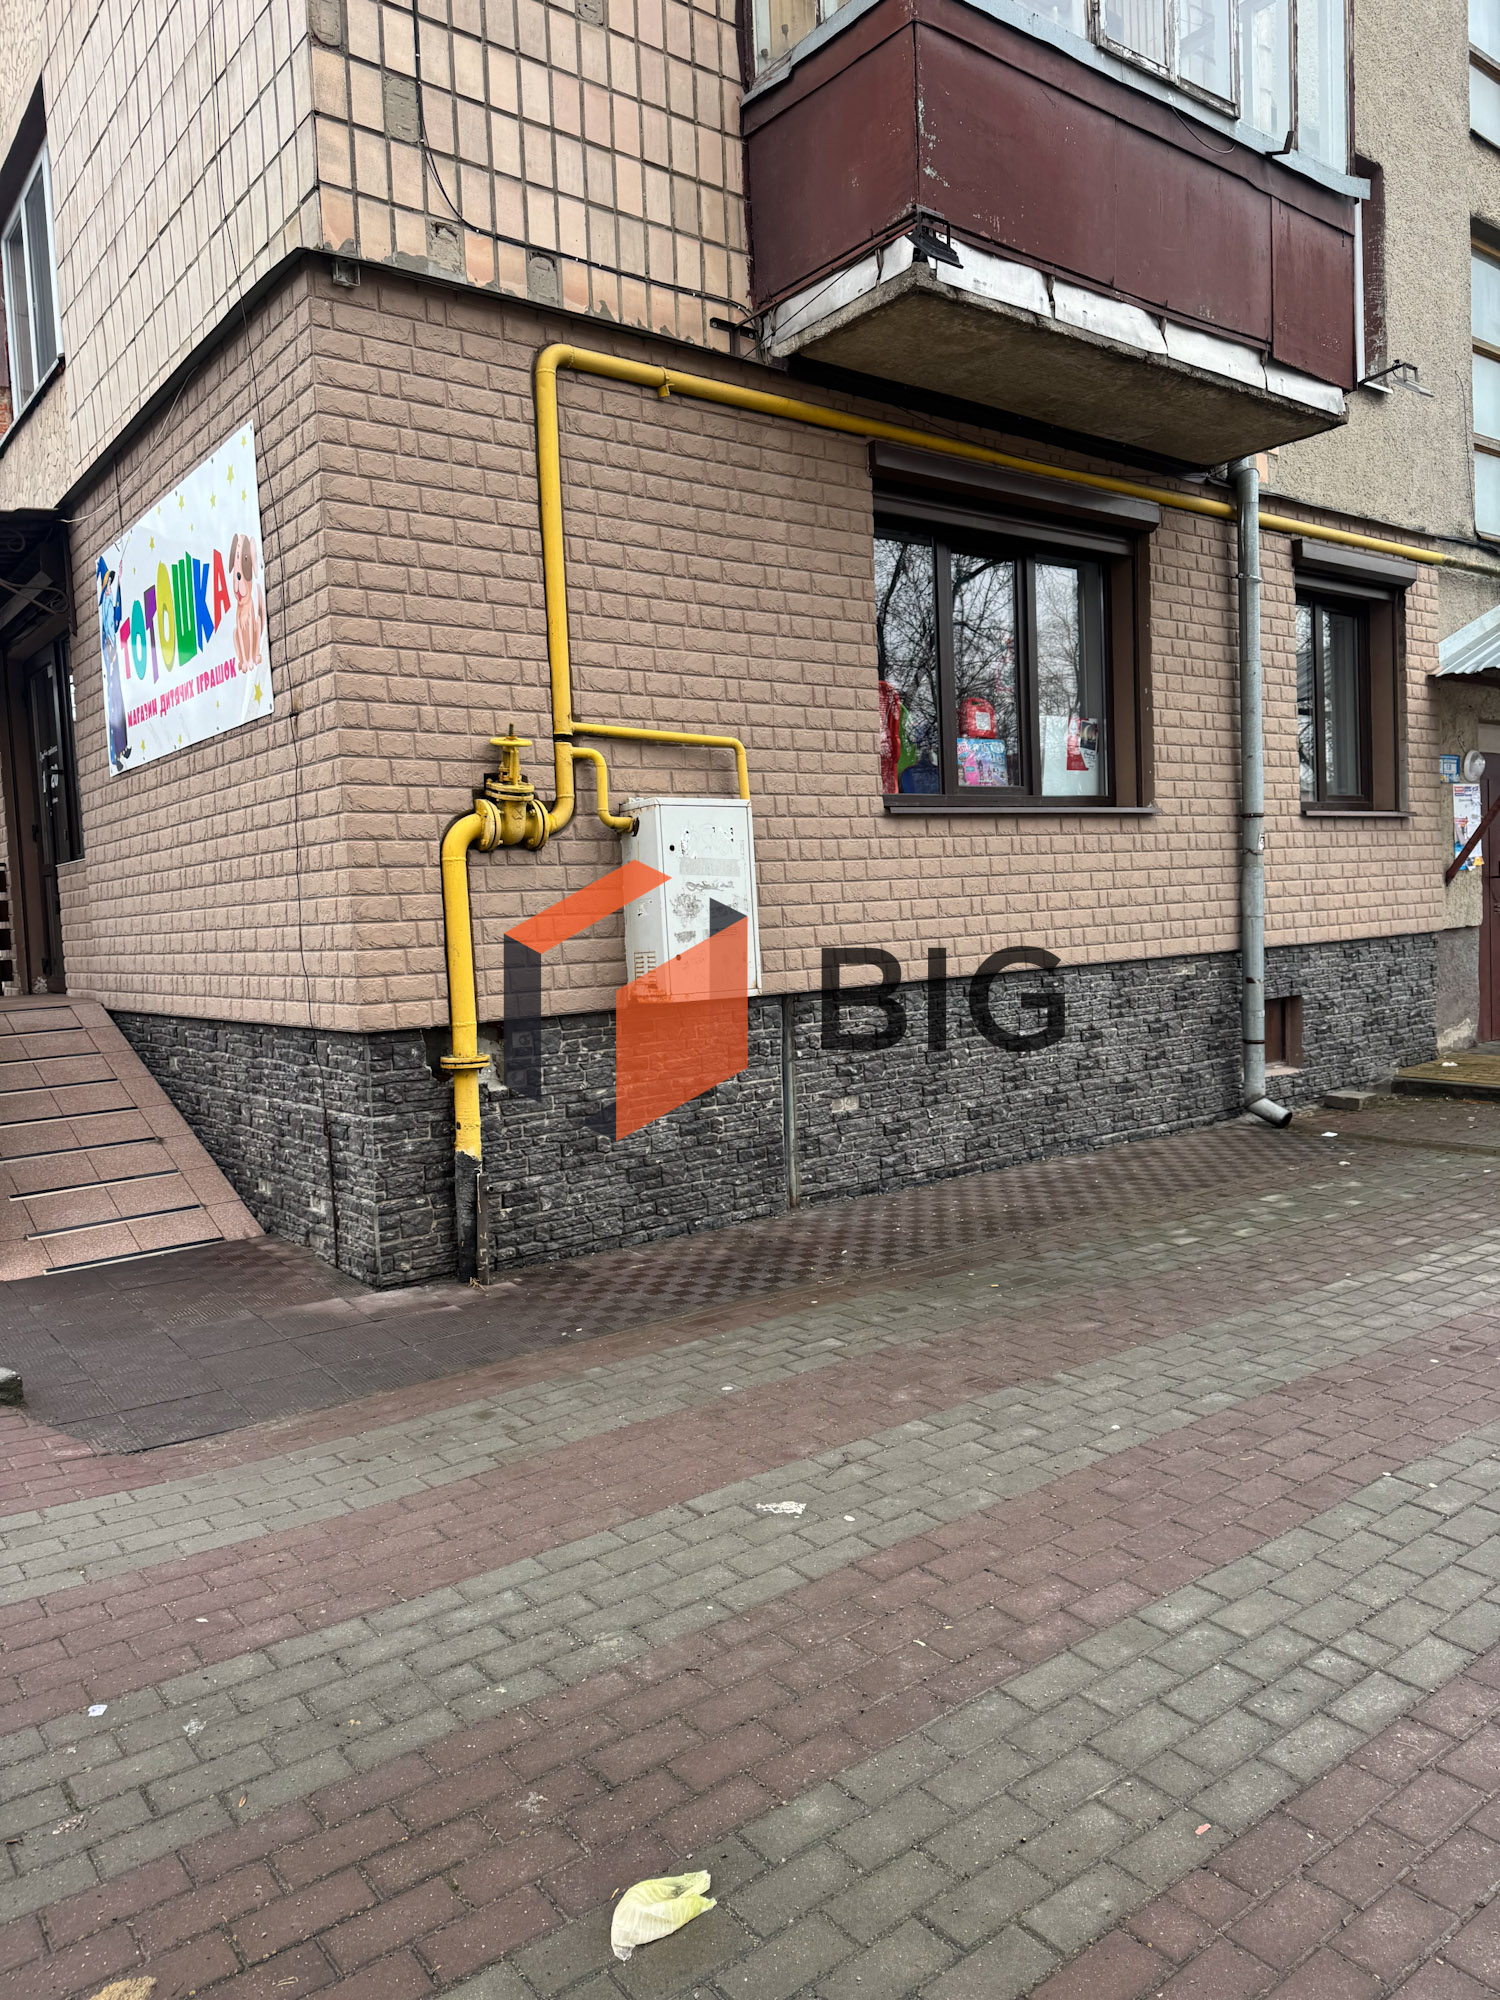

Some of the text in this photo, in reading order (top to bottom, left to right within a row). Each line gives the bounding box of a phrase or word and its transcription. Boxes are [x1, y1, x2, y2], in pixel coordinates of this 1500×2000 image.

[119, 549, 231, 684] ТОТОШКА
[127, 657, 237, 728] МАГАЗИН ДИТЯЧИХ ІГРАШОК
